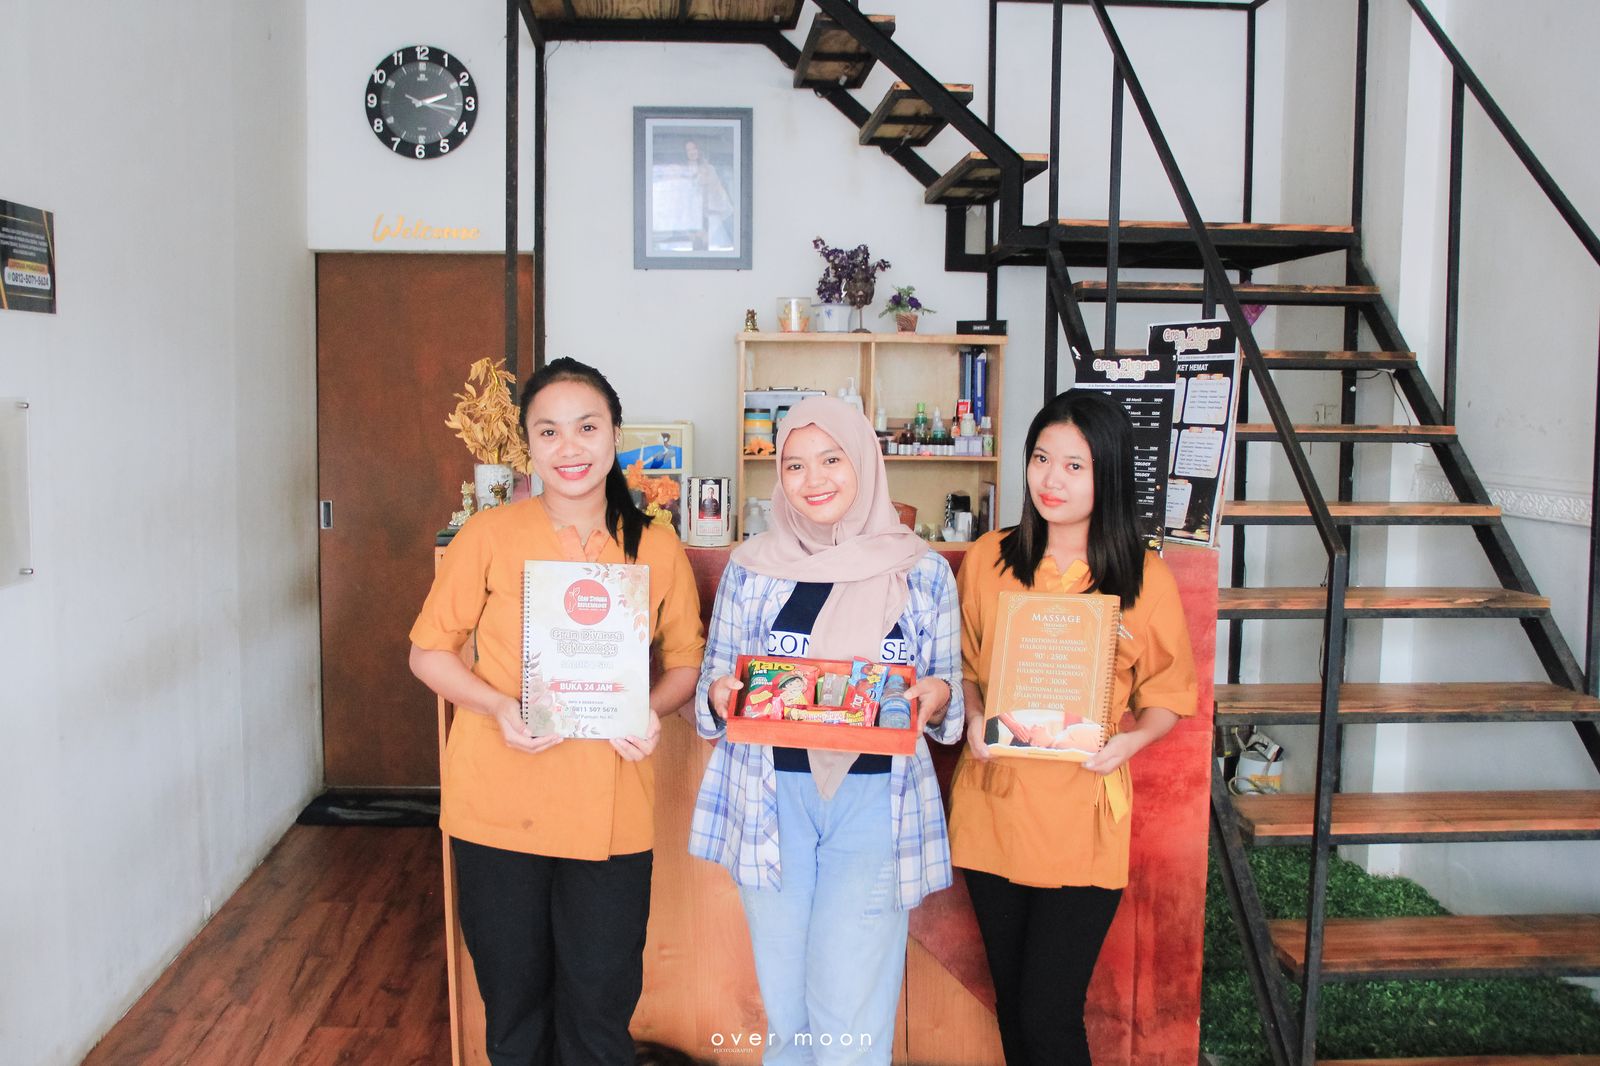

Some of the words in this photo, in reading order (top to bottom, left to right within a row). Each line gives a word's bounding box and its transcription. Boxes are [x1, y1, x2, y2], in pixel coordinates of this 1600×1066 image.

[393, 52, 403, 65] 11
[415, 46, 429, 60] 12
[443, 53, 448, 67] 1
[373, 70, 386, 84] 10
[460, 72, 469, 86] 2
[367, 94, 377, 107] 9
[465, 97, 475, 111] 3
[374, 119, 384, 133] 8
[458, 122, 468, 135] 4
[391, 138, 401, 151] 7
[440, 139, 450, 153] 5
[415, 145, 425, 159] 6
[372, 213, 480, 244] Welcome
[1093, 359, 1118, 371] Gran
[1032, 613, 1081, 623] MASSAGE
[752, 660, 796, 671] Taro
[560, 682, 582, 691] BUKA
[584, 683, 594, 691] 24
[596, 683, 613, 692] JAM
